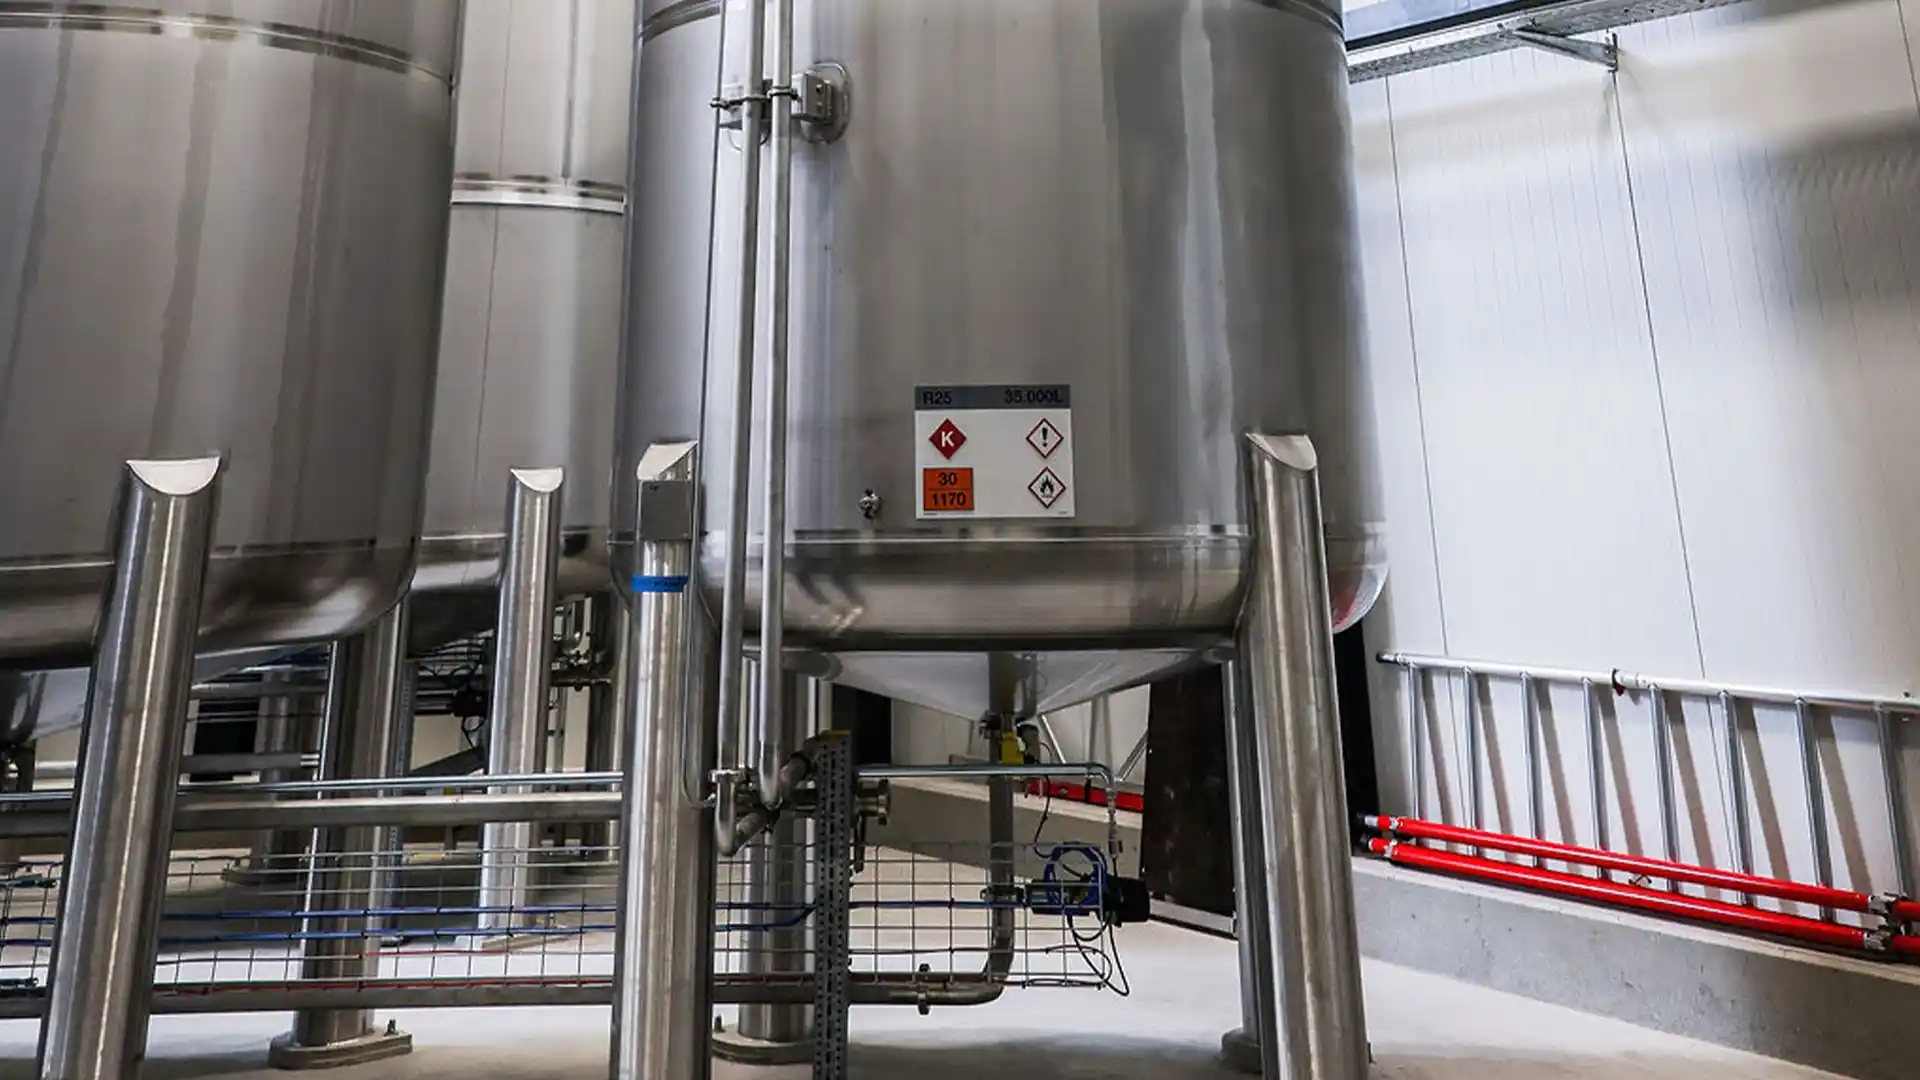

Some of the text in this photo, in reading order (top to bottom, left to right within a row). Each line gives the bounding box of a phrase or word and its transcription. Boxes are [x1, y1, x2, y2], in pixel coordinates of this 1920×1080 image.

[923, 389, 1064, 405] R25 35.000L
[941, 431, 954, 447] K
[938, 472, 958, 486] 30
[932, 493, 966, 507] 1170
